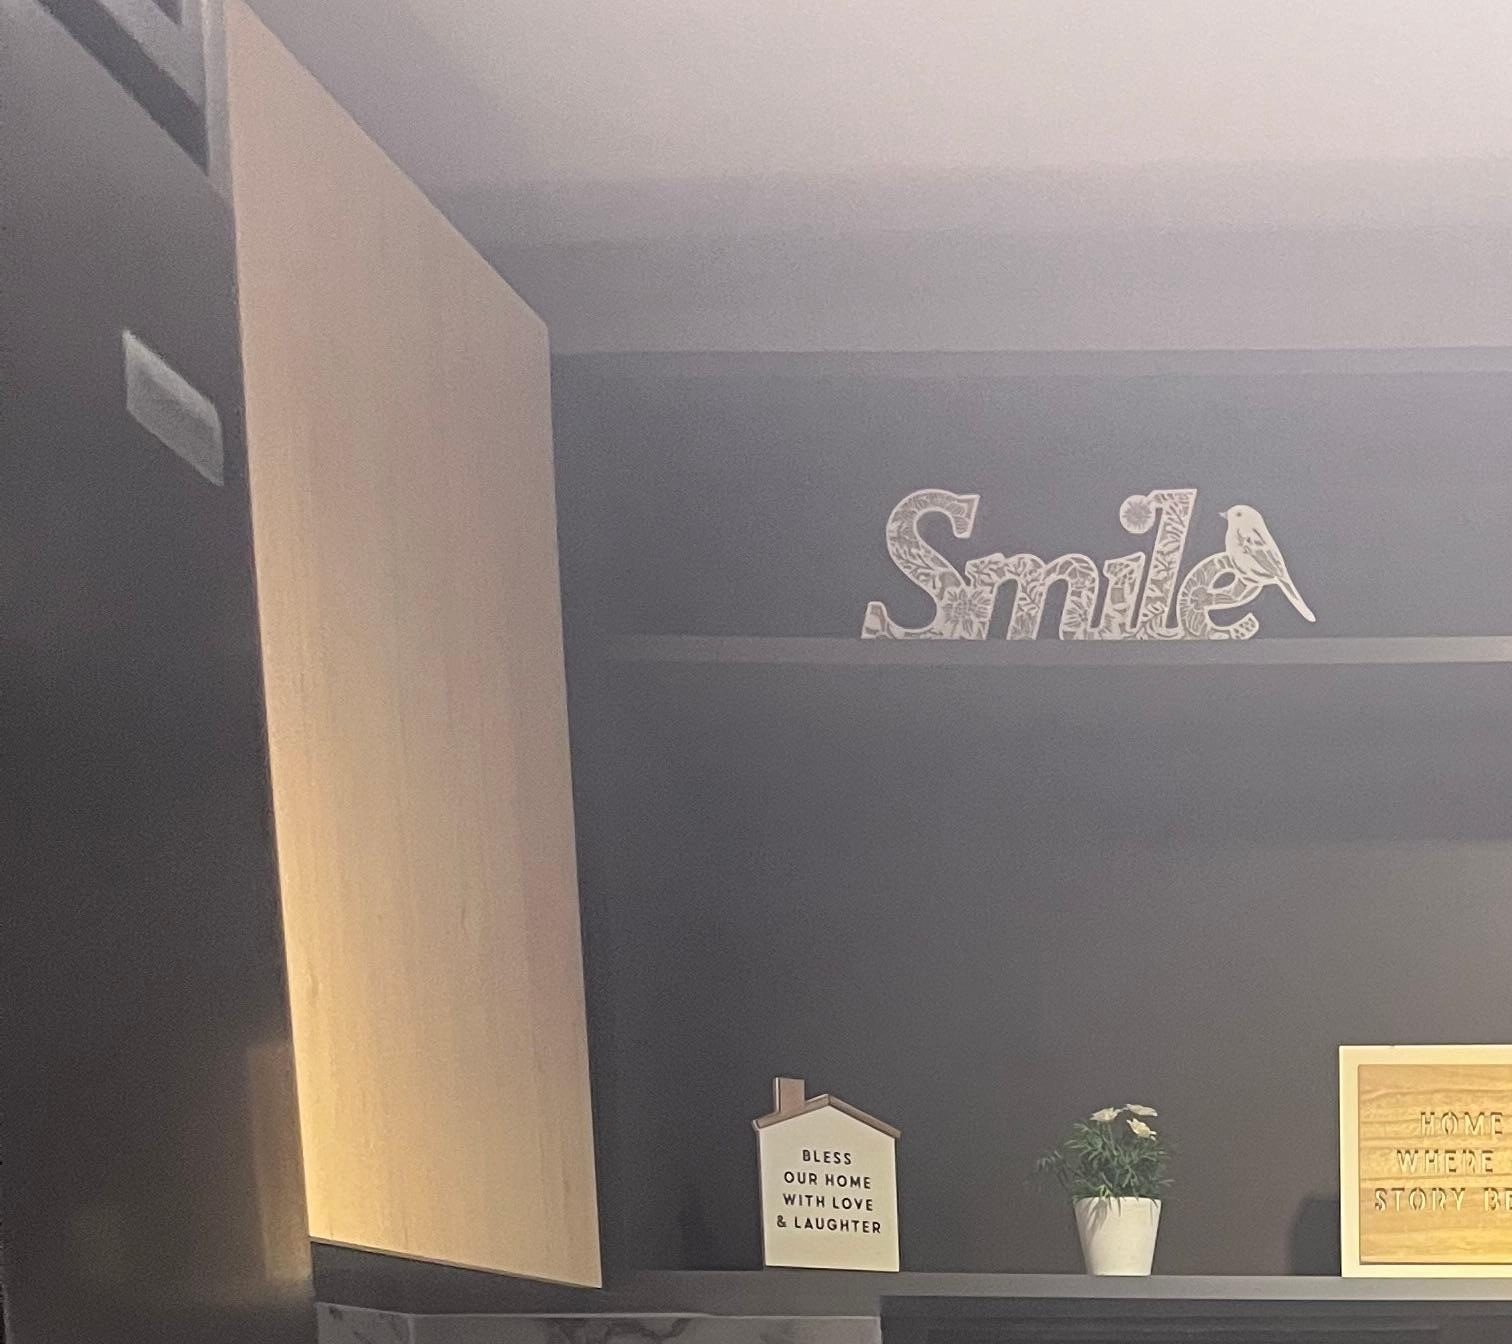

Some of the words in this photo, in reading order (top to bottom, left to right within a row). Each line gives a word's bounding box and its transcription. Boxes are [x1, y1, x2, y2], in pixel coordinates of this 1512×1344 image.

[860, 487, 1262, 641] Smile
[1419, 1111, 1505, 1136] HOME
[802, 1148, 852, 1165] BLESS
[1395, 1149, 1495, 1174] WHERE
[783, 1171, 817, 1185] OUR
[824, 1173, 872, 1189] HOME
[782, 1192, 825, 1208] WITH
[832, 1196, 873, 1211] LOVE
[1373, 1186, 1468, 1212] STORY
[776, 1215, 787, 1228] &
[794, 1216, 881, 1234] LAUGHTER
